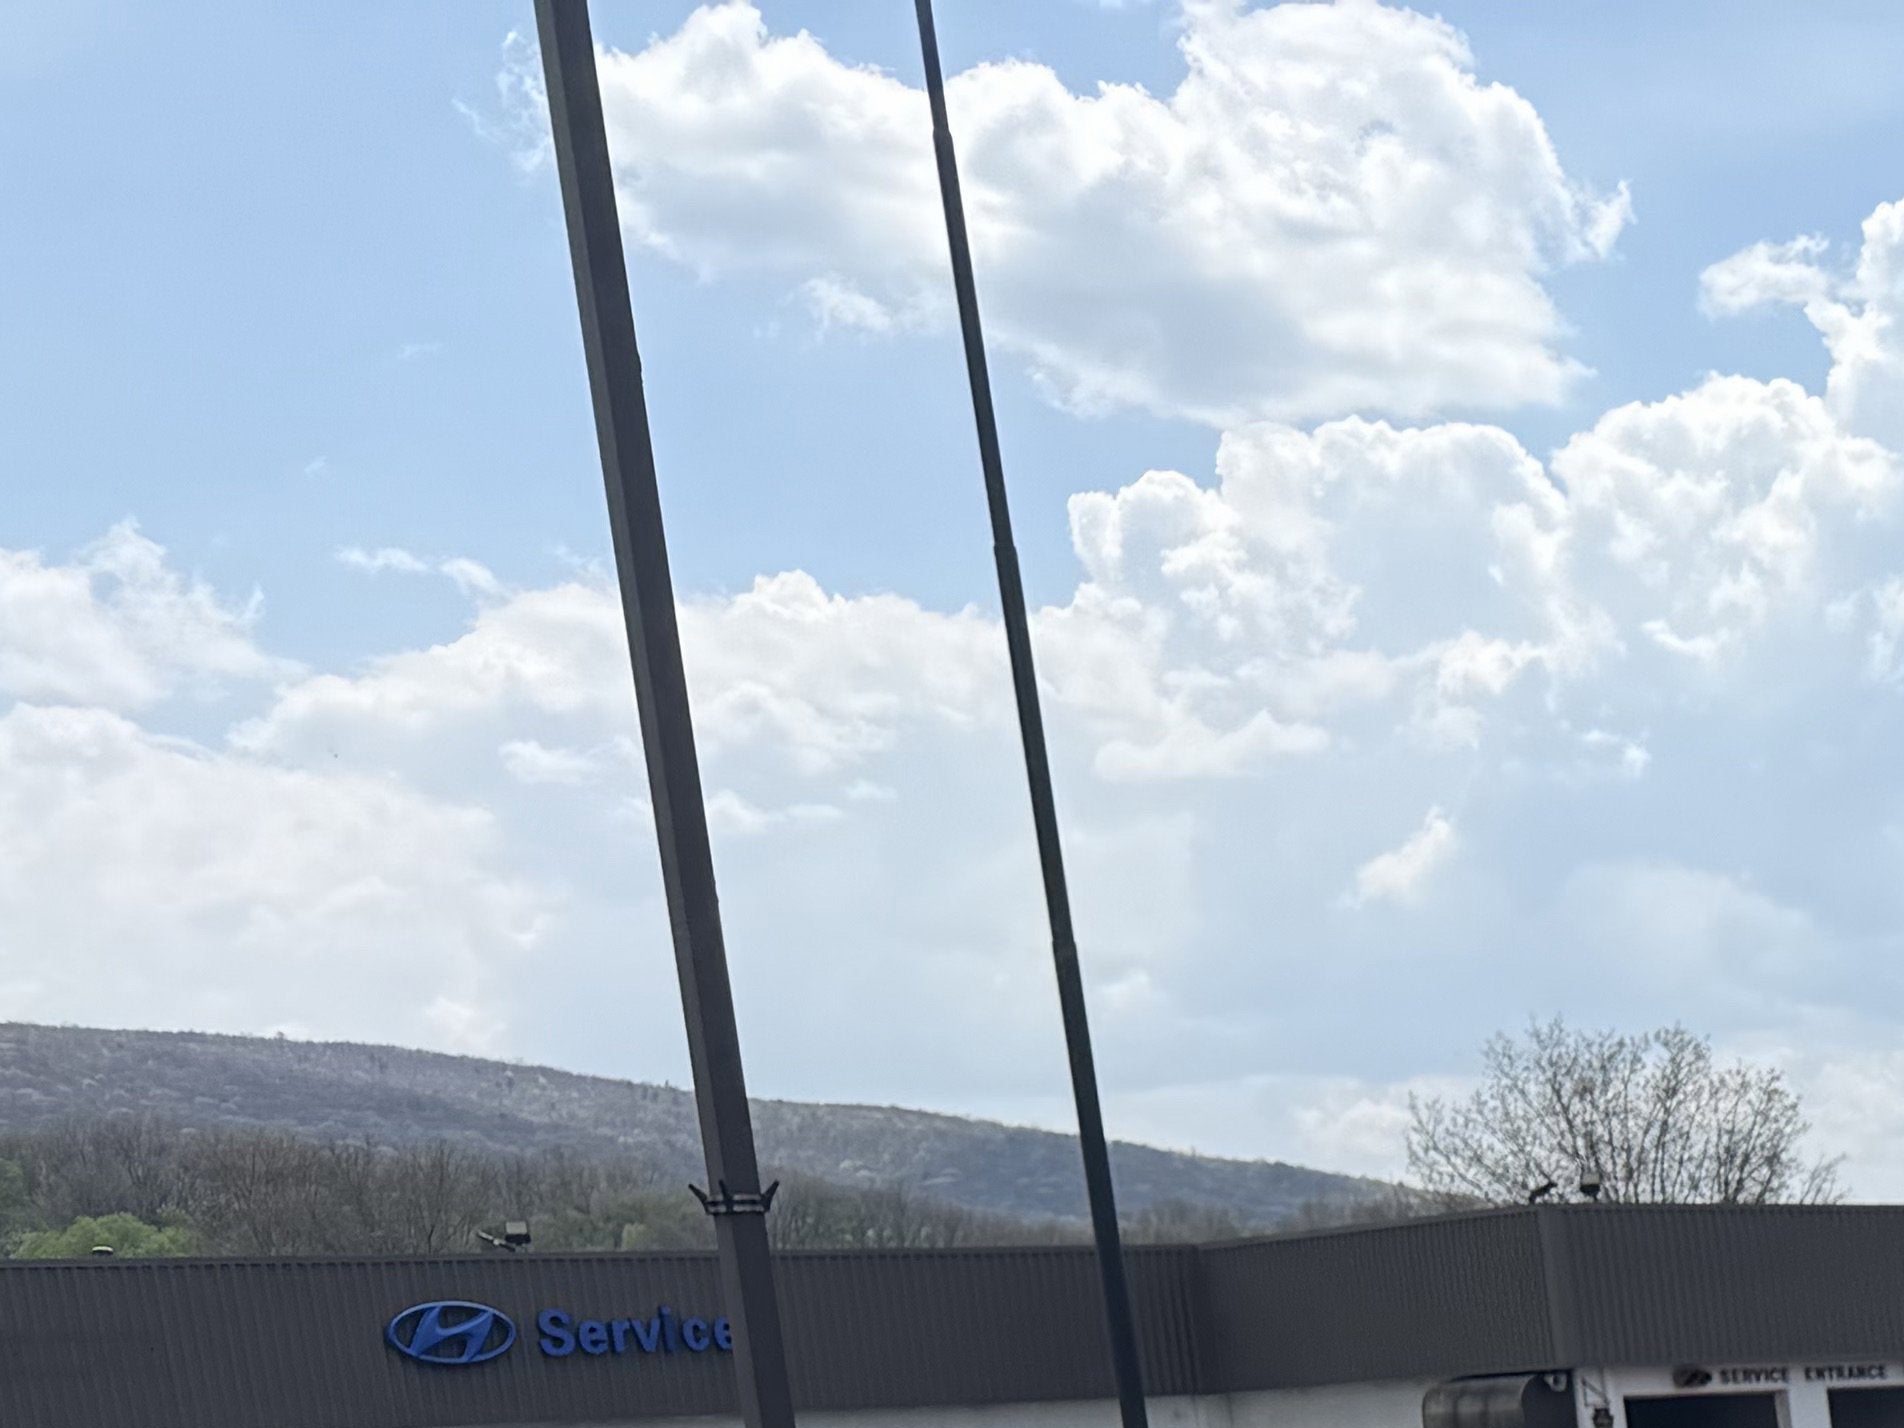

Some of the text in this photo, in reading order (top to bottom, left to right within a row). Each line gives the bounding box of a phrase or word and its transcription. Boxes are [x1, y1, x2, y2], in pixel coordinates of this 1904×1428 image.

[538, 1305, 735, 1357] Service
[1719, 1365, 1886, 1384] SERVICE ENTRANCE
